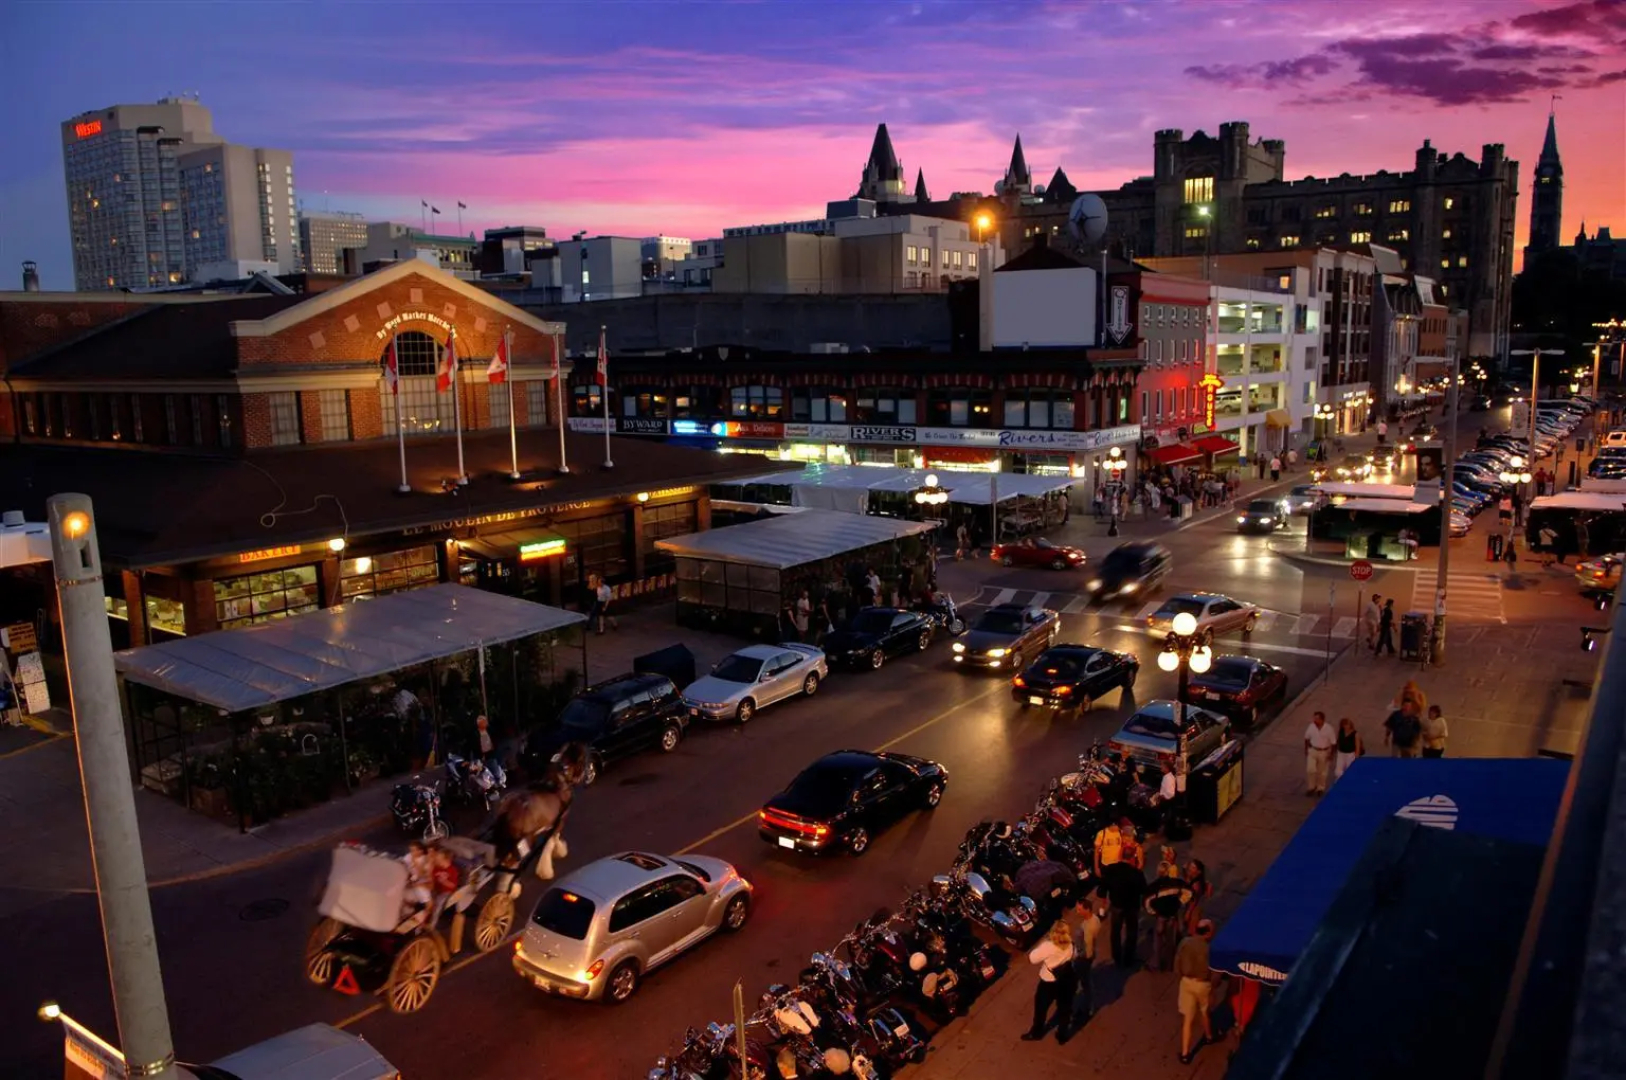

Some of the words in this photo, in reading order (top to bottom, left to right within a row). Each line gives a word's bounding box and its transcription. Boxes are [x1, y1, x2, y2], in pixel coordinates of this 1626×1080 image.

[402, 312, 427, 321] Market
[623, 420, 663, 430] BYWARD
[998, 430, 1055, 446] Rivers
[239, 545, 301, 562] BAKERY
[1352, 566, 1372, 575] STOP
